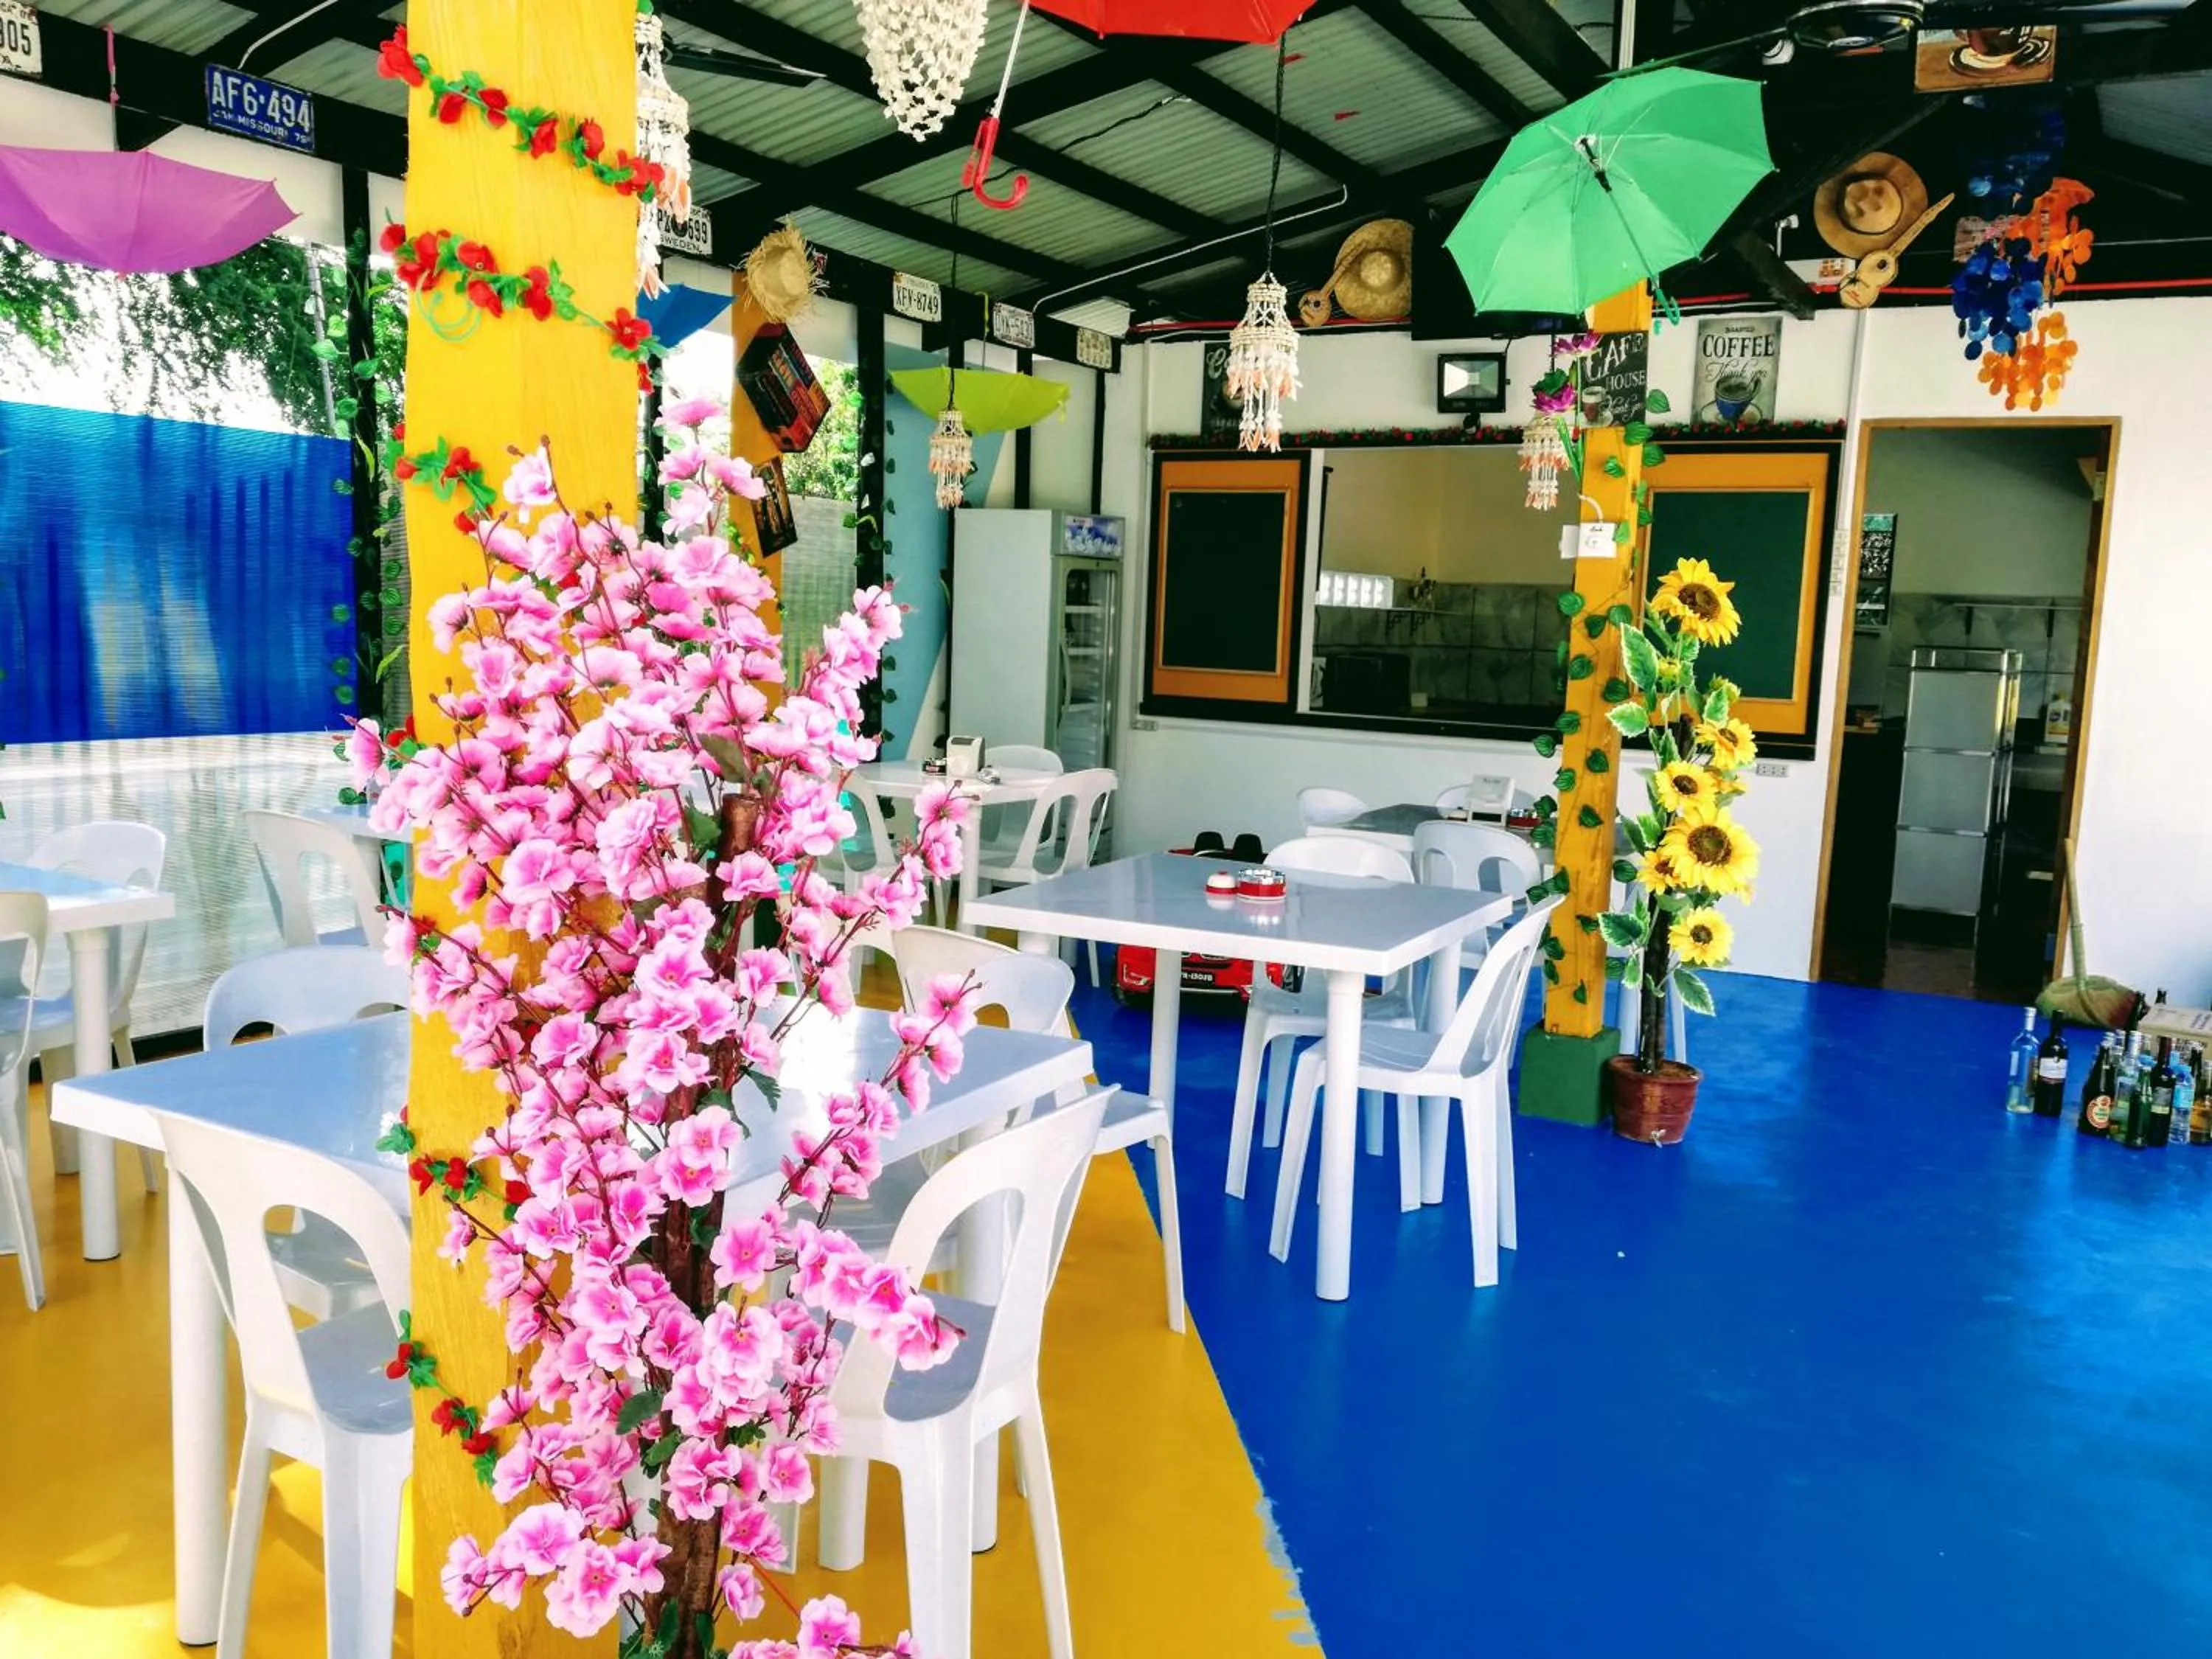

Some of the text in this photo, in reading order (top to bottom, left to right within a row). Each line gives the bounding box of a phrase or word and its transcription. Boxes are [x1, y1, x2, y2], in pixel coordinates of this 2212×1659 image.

[1583, 333, 1644, 382] CAFE
[1703, 333, 1775, 358] COFFEE
[1605, 369, 1646, 390] HOUSE
